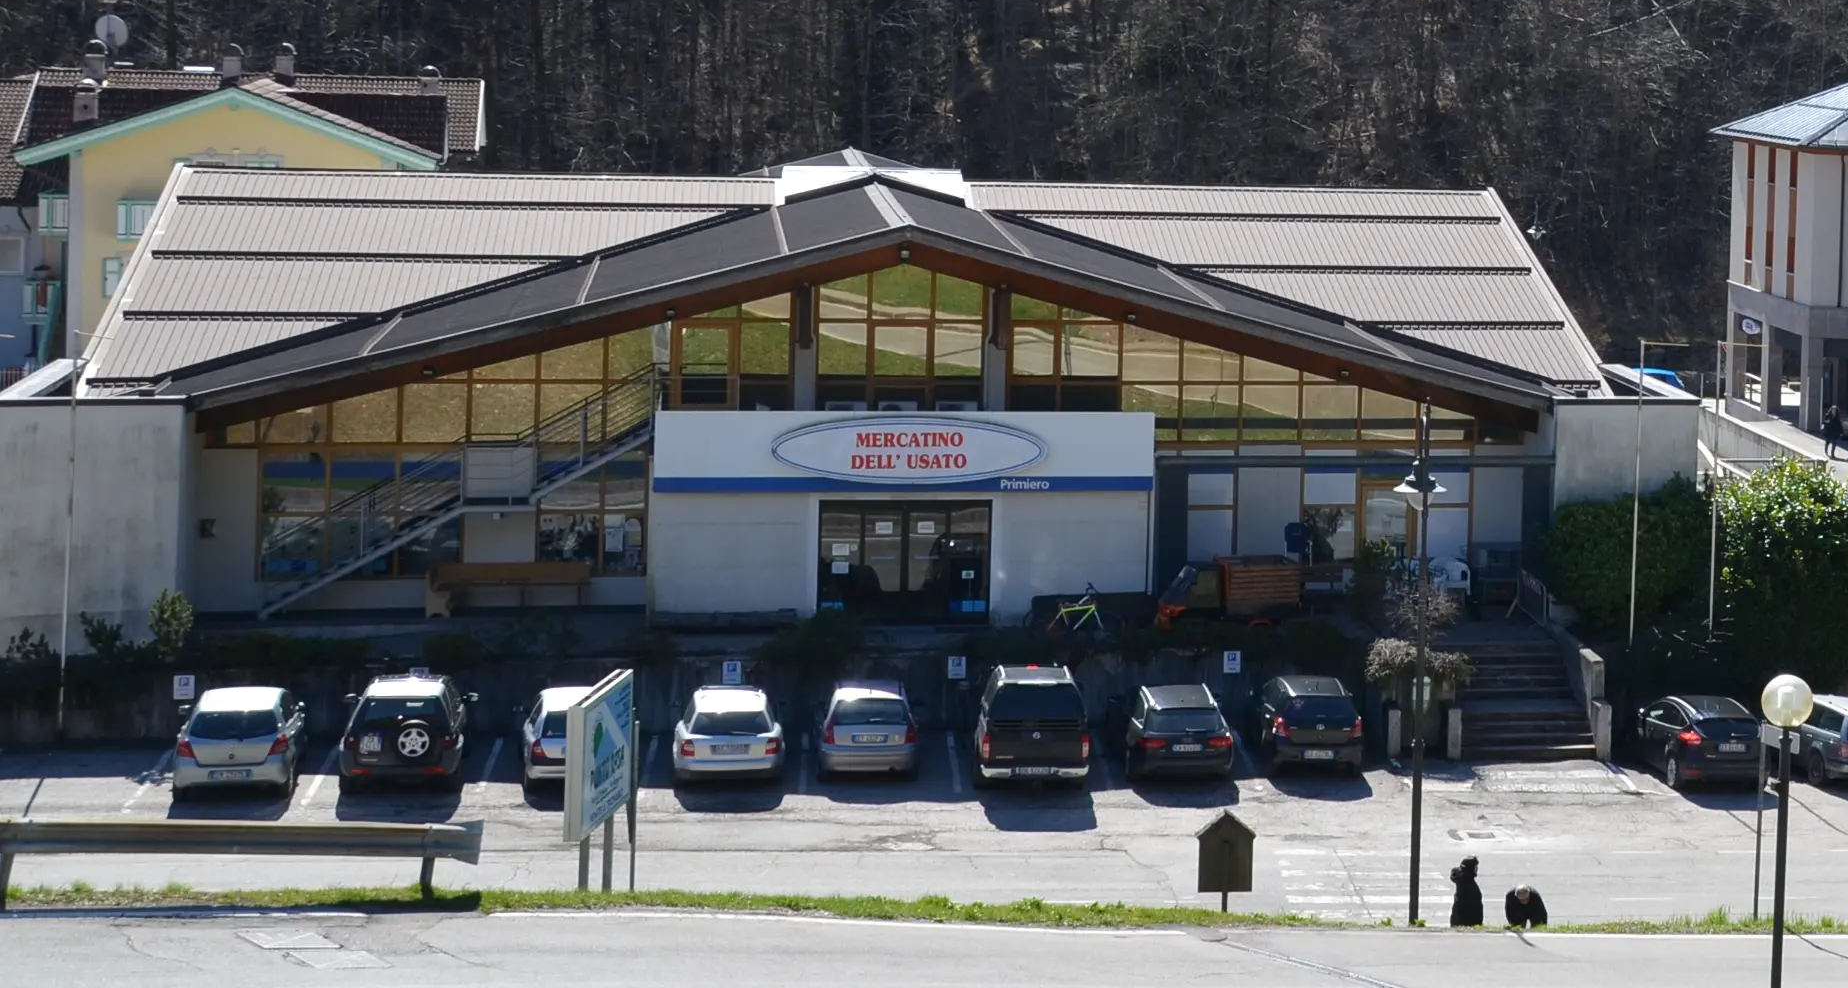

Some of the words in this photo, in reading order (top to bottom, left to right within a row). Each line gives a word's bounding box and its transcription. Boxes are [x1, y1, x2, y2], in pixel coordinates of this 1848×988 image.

[856, 432, 964, 448] MERCATINO
[851, 454, 901, 470] DELL'
[906, 453, 968, 470] USATO
[1000, 477, 1050, 490] Primiero
